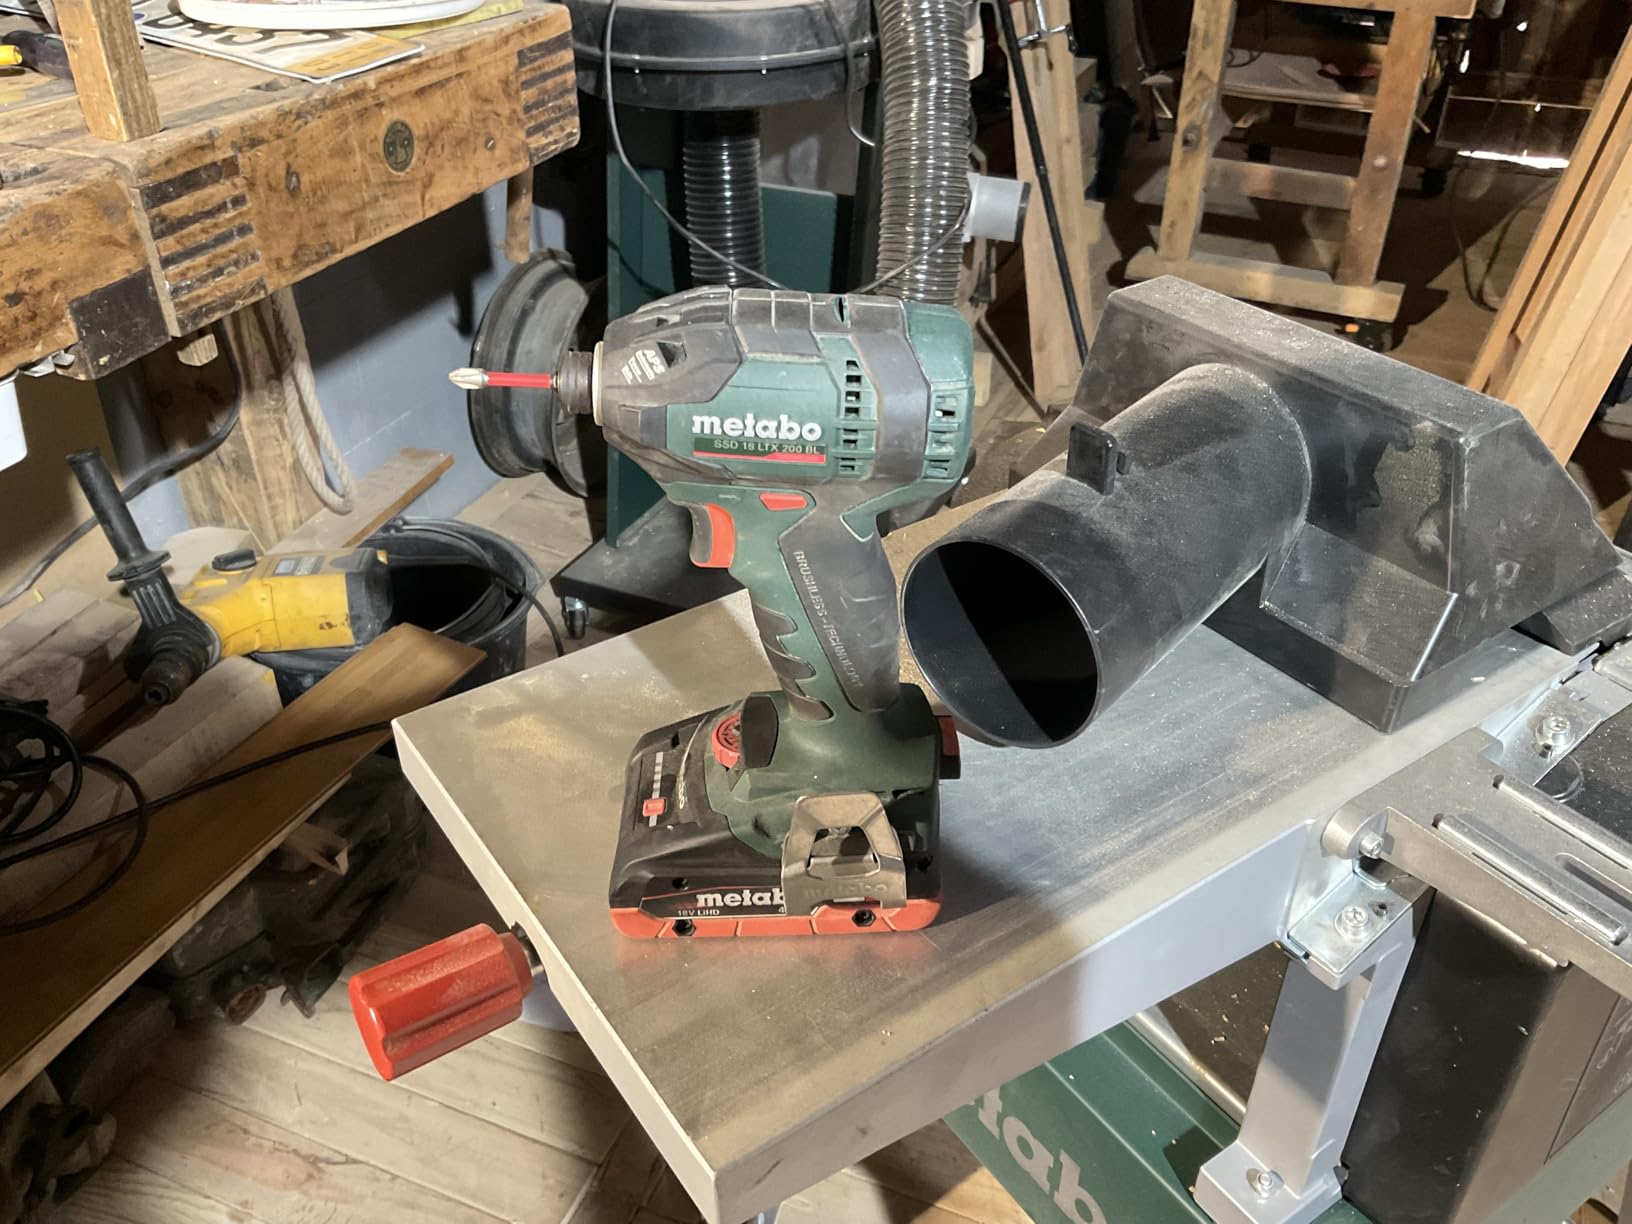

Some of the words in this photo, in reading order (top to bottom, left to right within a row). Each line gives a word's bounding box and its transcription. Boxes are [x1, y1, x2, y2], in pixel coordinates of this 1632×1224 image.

[691, 413, 823, 442] metabo
[713, 439, 739, 450] SSD
[742, 441, 755, 451] 18
[757, 442, 778, 453] LTX
[782, 444, 803, 454] 200
[805, 446, 820, 455] BL
[695, 887, 786, 908] metab
[677, 909, 695, 917] 18V
[697, 908, 720, 917] LiHD
